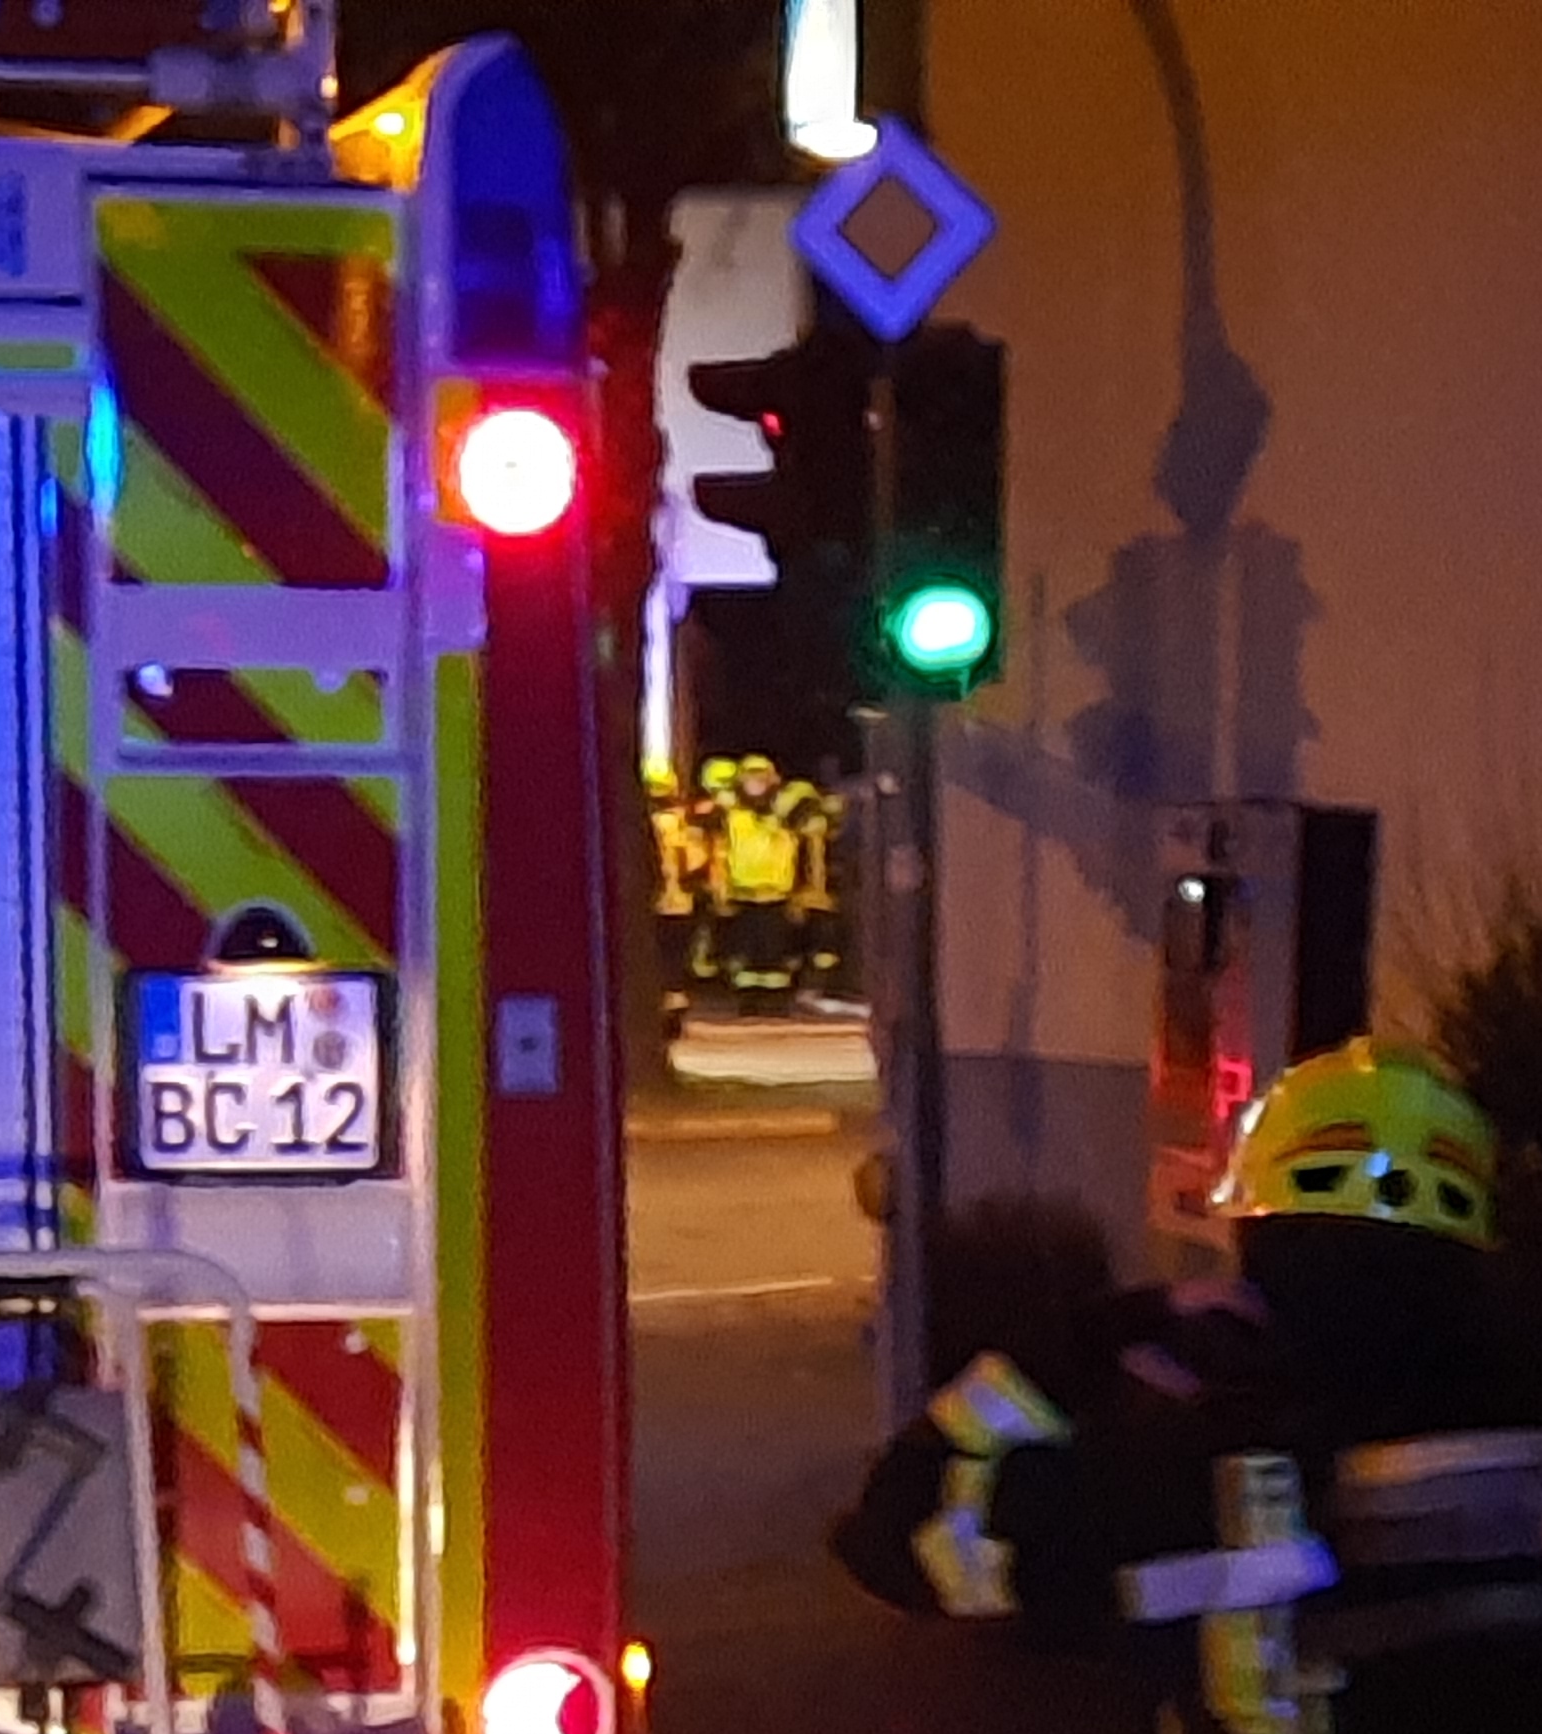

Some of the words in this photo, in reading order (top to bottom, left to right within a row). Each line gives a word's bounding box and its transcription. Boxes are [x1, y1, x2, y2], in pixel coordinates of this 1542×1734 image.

[191, 991, 296, 1064] LM
[151, 1081, 252, 1153] BC
[271, 1081, 369, 1153] 12
